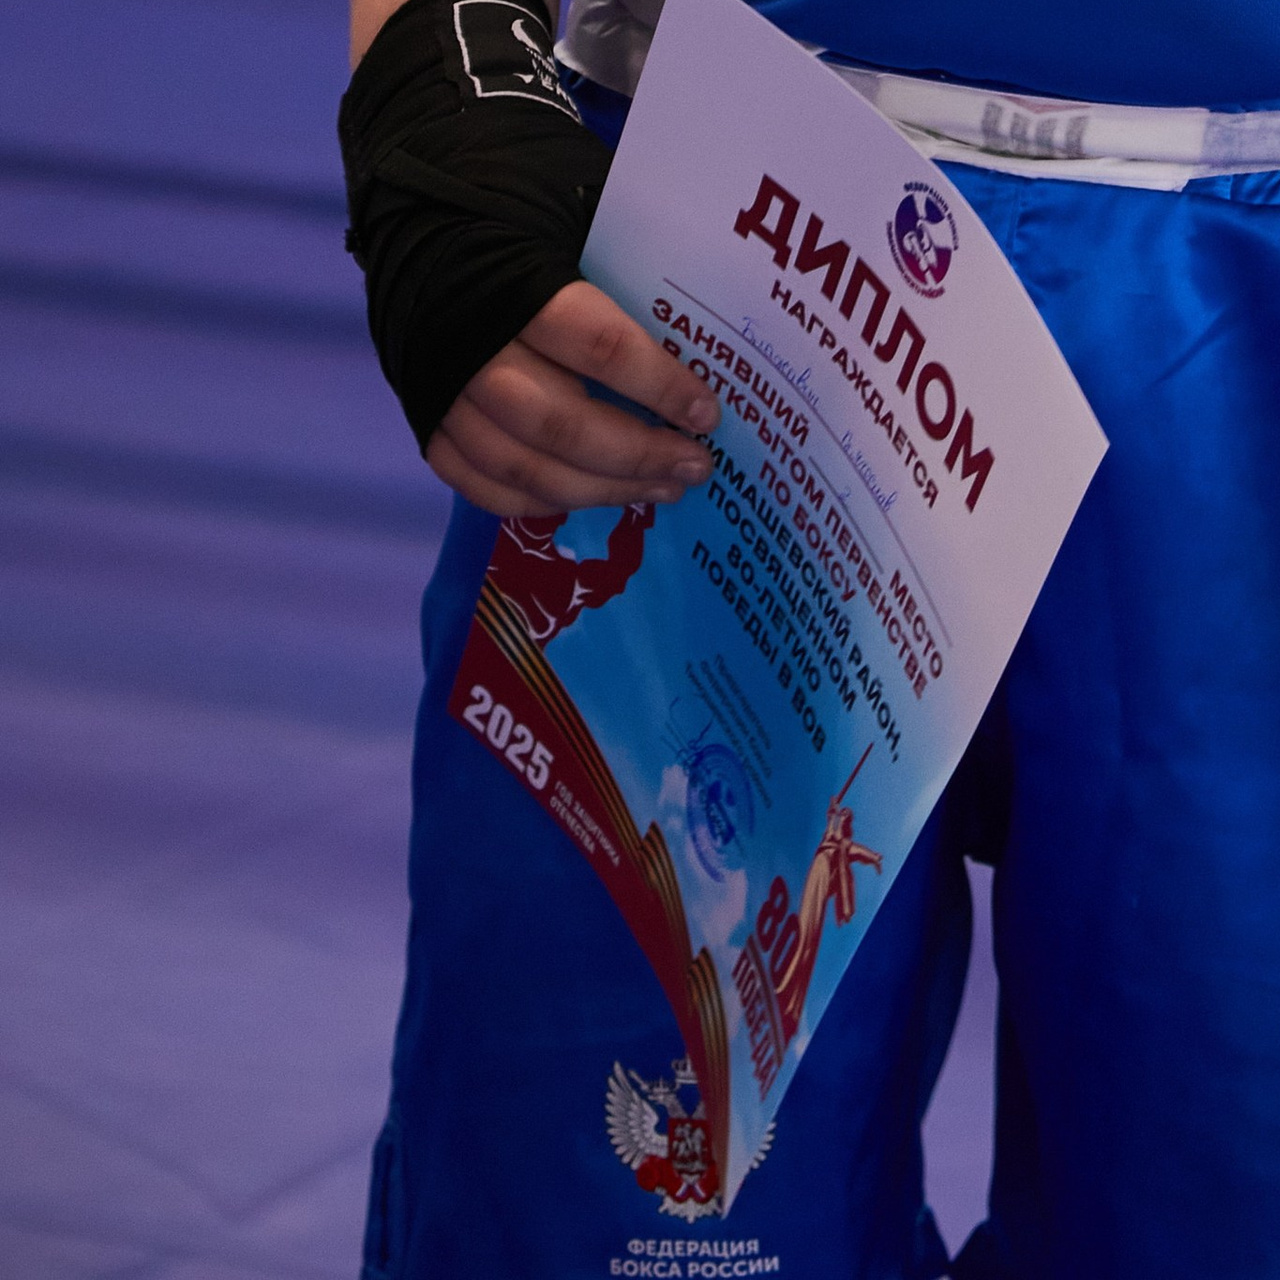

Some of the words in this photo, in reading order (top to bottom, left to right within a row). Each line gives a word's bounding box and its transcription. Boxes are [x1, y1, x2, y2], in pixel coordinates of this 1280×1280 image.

[652, 297, 810, 447] ЗАНЯВШИЙ
[733, 173, 996, 513] ДИПЛОМ
[770, 279, 940, 509] НАГРАЖДАЕТСЯ
[688, 358, 826, 512] ОТКРЫТОМ
[824, 506, 928, 701] ПЕРВЕНСТВЕ
[707, 479, 859, 713] ПОСВЯЩЕННОМ
[759, 459, 791, 507] ПО
[792, 506, 856, 603] БОКСУ
[690, 539, 779, 665] ПОБЕДЫ
[777, 661, 793, 690] В
[791, 686, 827, 754] ВОВ
[727, 543, 822, 694] 80-ЛЕТИЮ
[889, 568, 944, 679] МЕСТО
[462, 684, 555, 791] 2025
[848, 643, 901, 764] РАЙОН,
[756, 876, 801, 994] 80
[609, 1257, 682, 1279] БОКСА
[687, 1255, 781, 1279] РОССИИ
[626, 1237, 760, 1260] ФЕДЕРАЦИЯ
